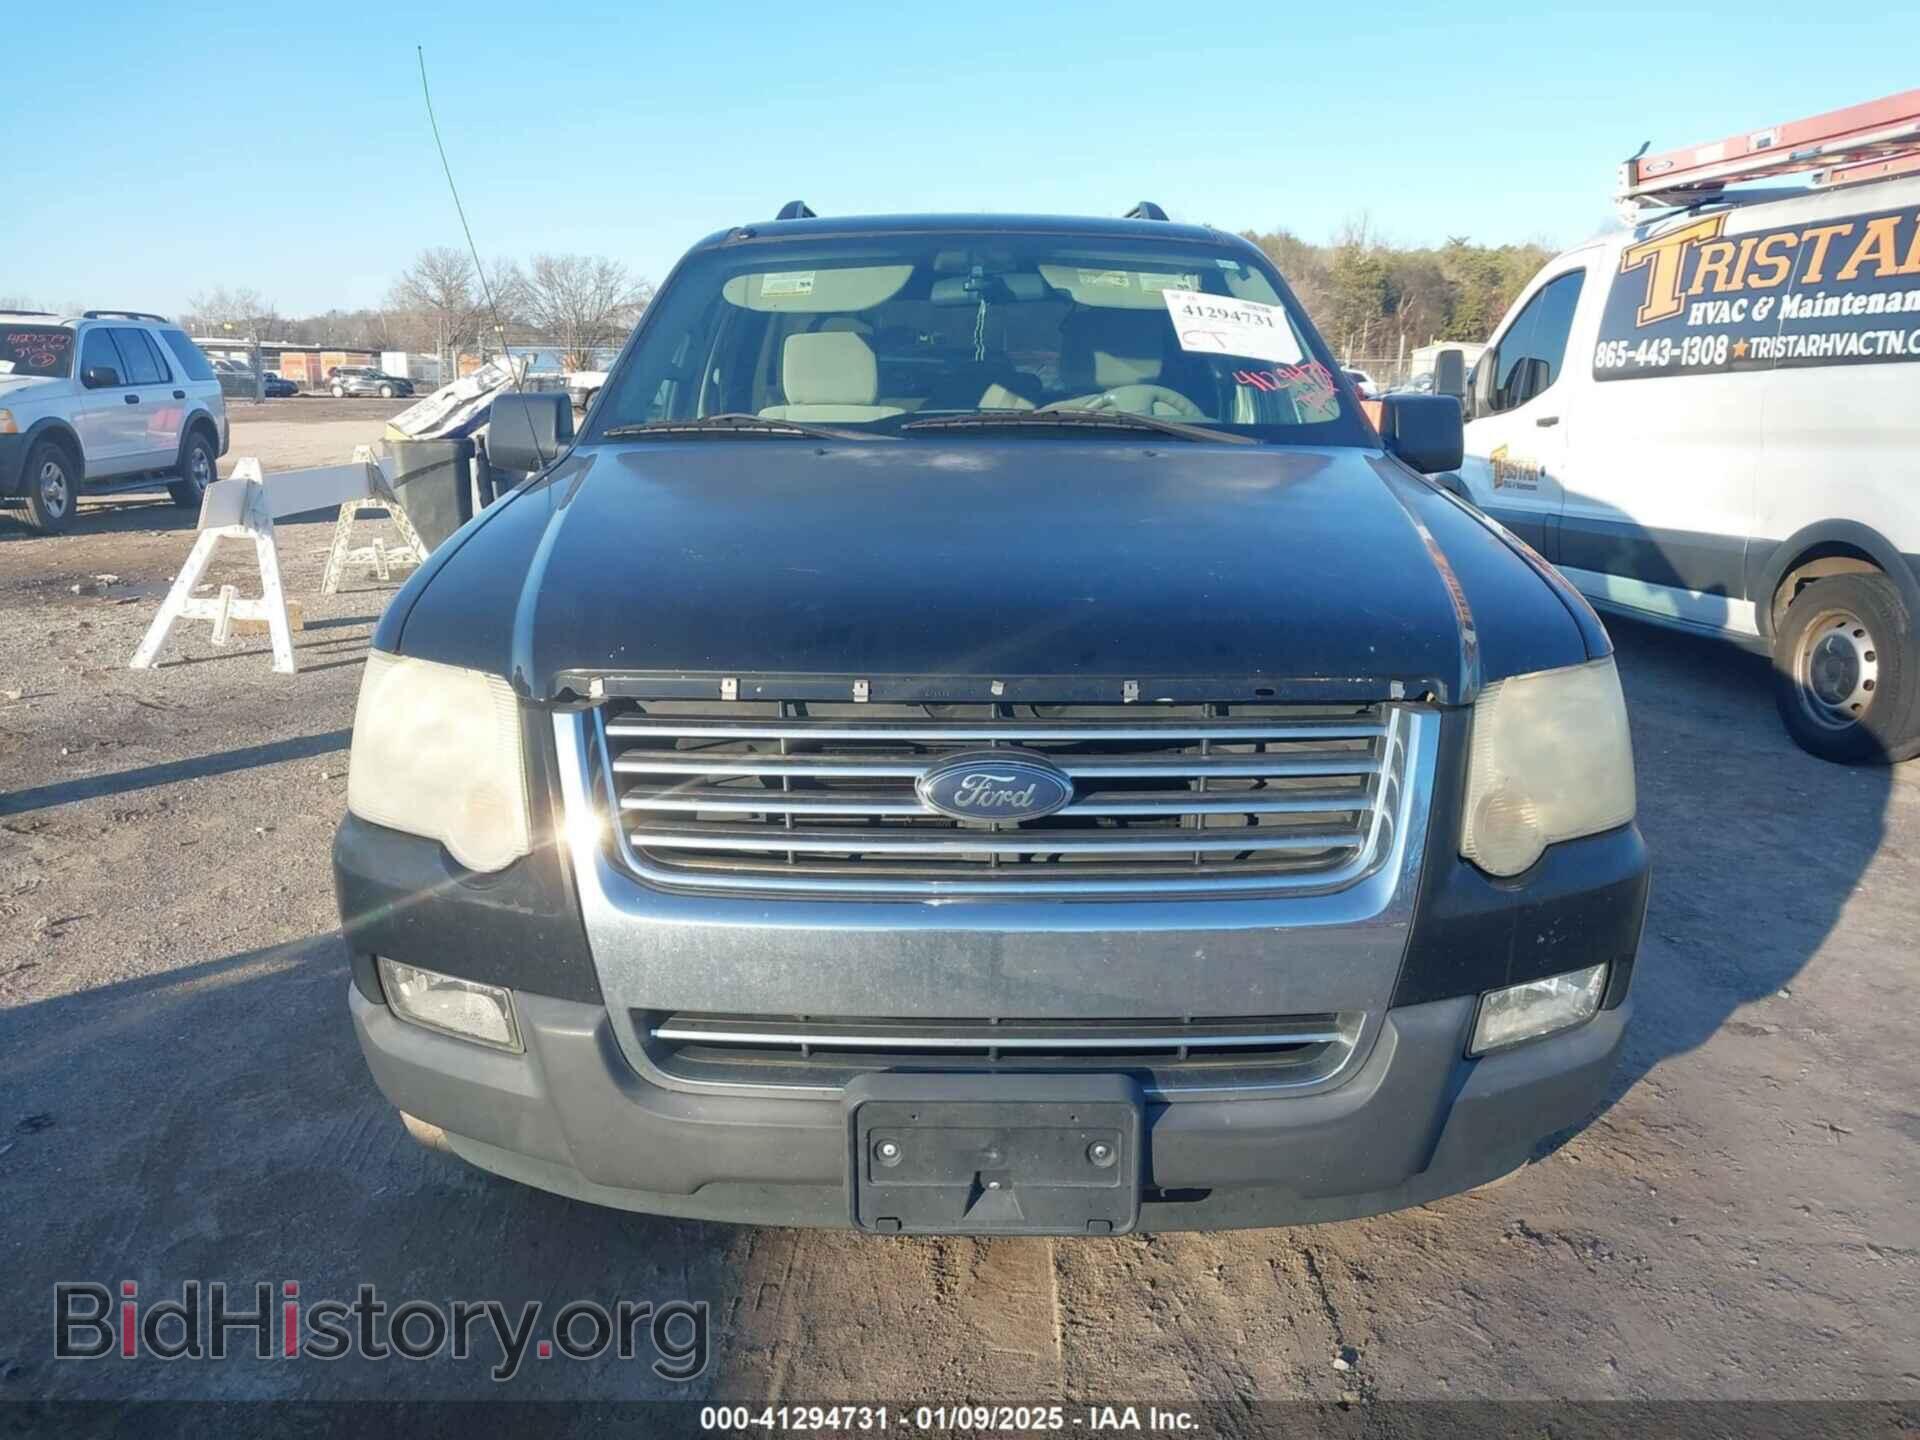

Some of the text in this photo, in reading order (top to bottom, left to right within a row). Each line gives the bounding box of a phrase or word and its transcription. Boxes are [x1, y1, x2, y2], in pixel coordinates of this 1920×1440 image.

[1182, 303, 1275, 329] 41294731
[1687, 298, 1747, 326] HVAC
[1752, 296, 1775, 321] &
[1594, 333, 1728, 368] 865-443-1308
[954, 773, 1037, 808] Ford
